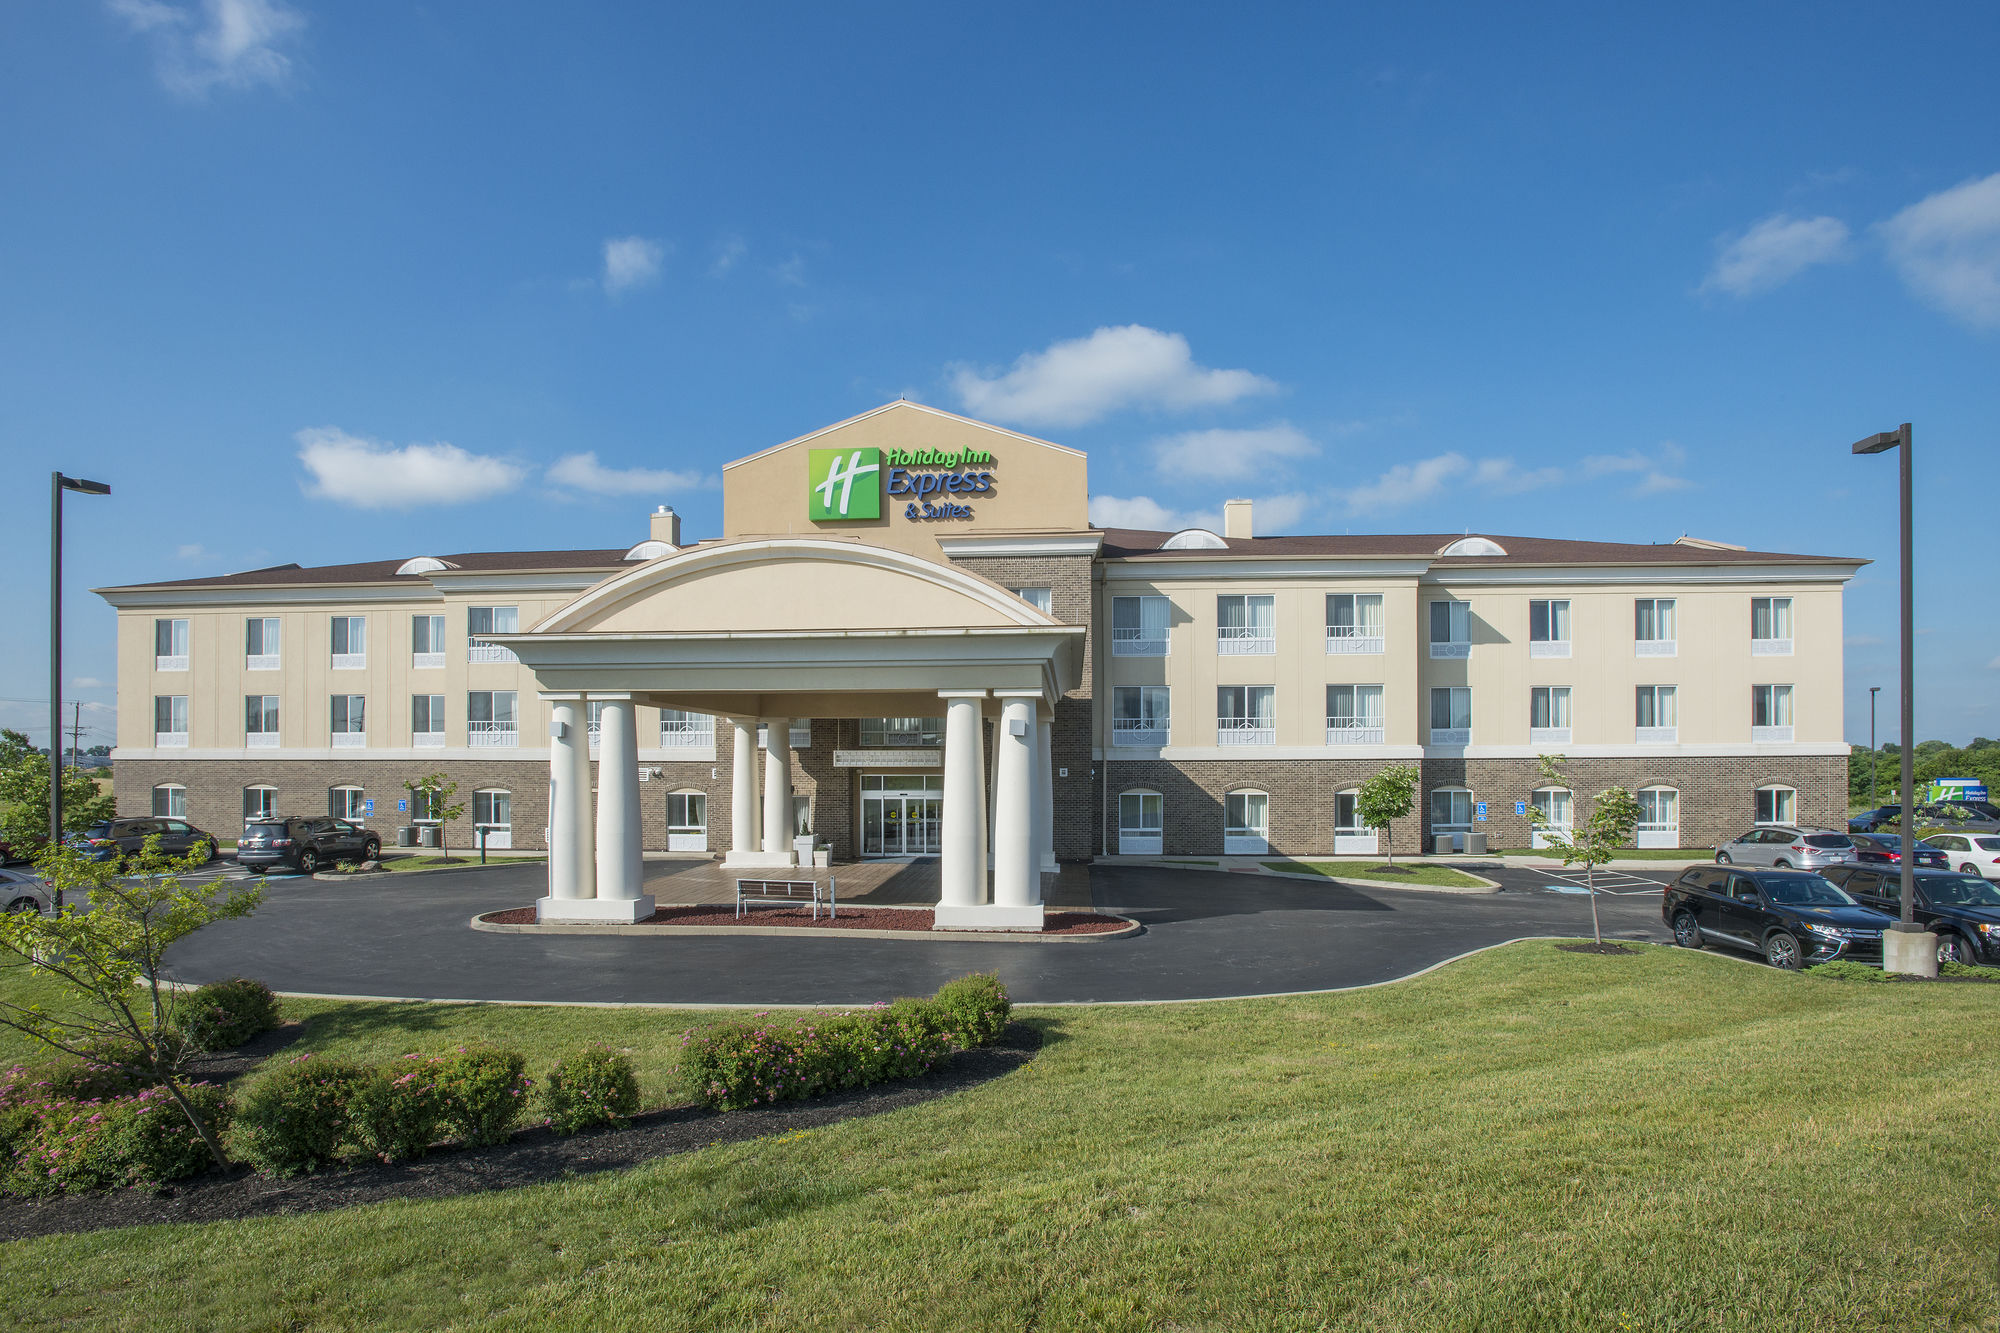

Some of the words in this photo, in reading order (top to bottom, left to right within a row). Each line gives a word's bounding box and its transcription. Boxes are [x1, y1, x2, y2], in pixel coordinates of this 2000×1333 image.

[886, 446, 958, 468] Holiday
[961, 445, 991, 464] Inn
[815, 451, 880, 515] H
[886, 468, 991, 500] Express
[904, 502, 917, 519] &
[920, 502, 971, 519] Suites
